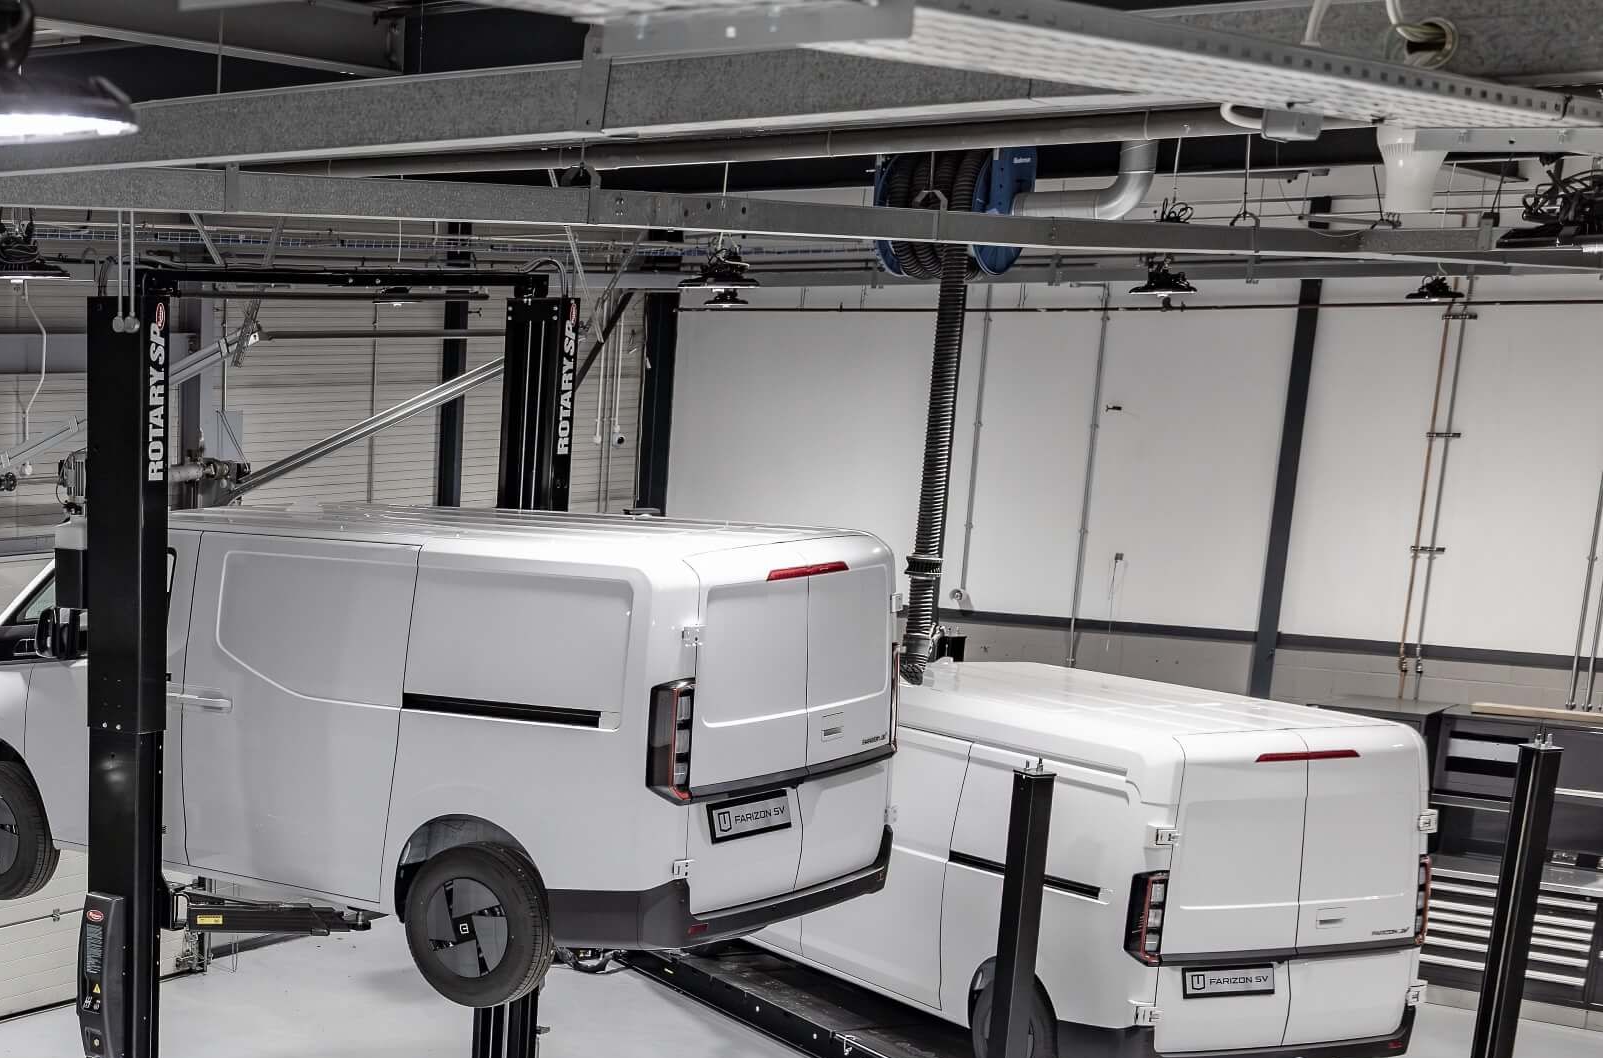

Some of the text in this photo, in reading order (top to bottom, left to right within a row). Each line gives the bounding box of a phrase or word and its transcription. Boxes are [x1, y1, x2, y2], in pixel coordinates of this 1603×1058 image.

[734, 806, 786, 824] FARIZON SV
[1209, 975, 1269, 985] FARIZON SV
